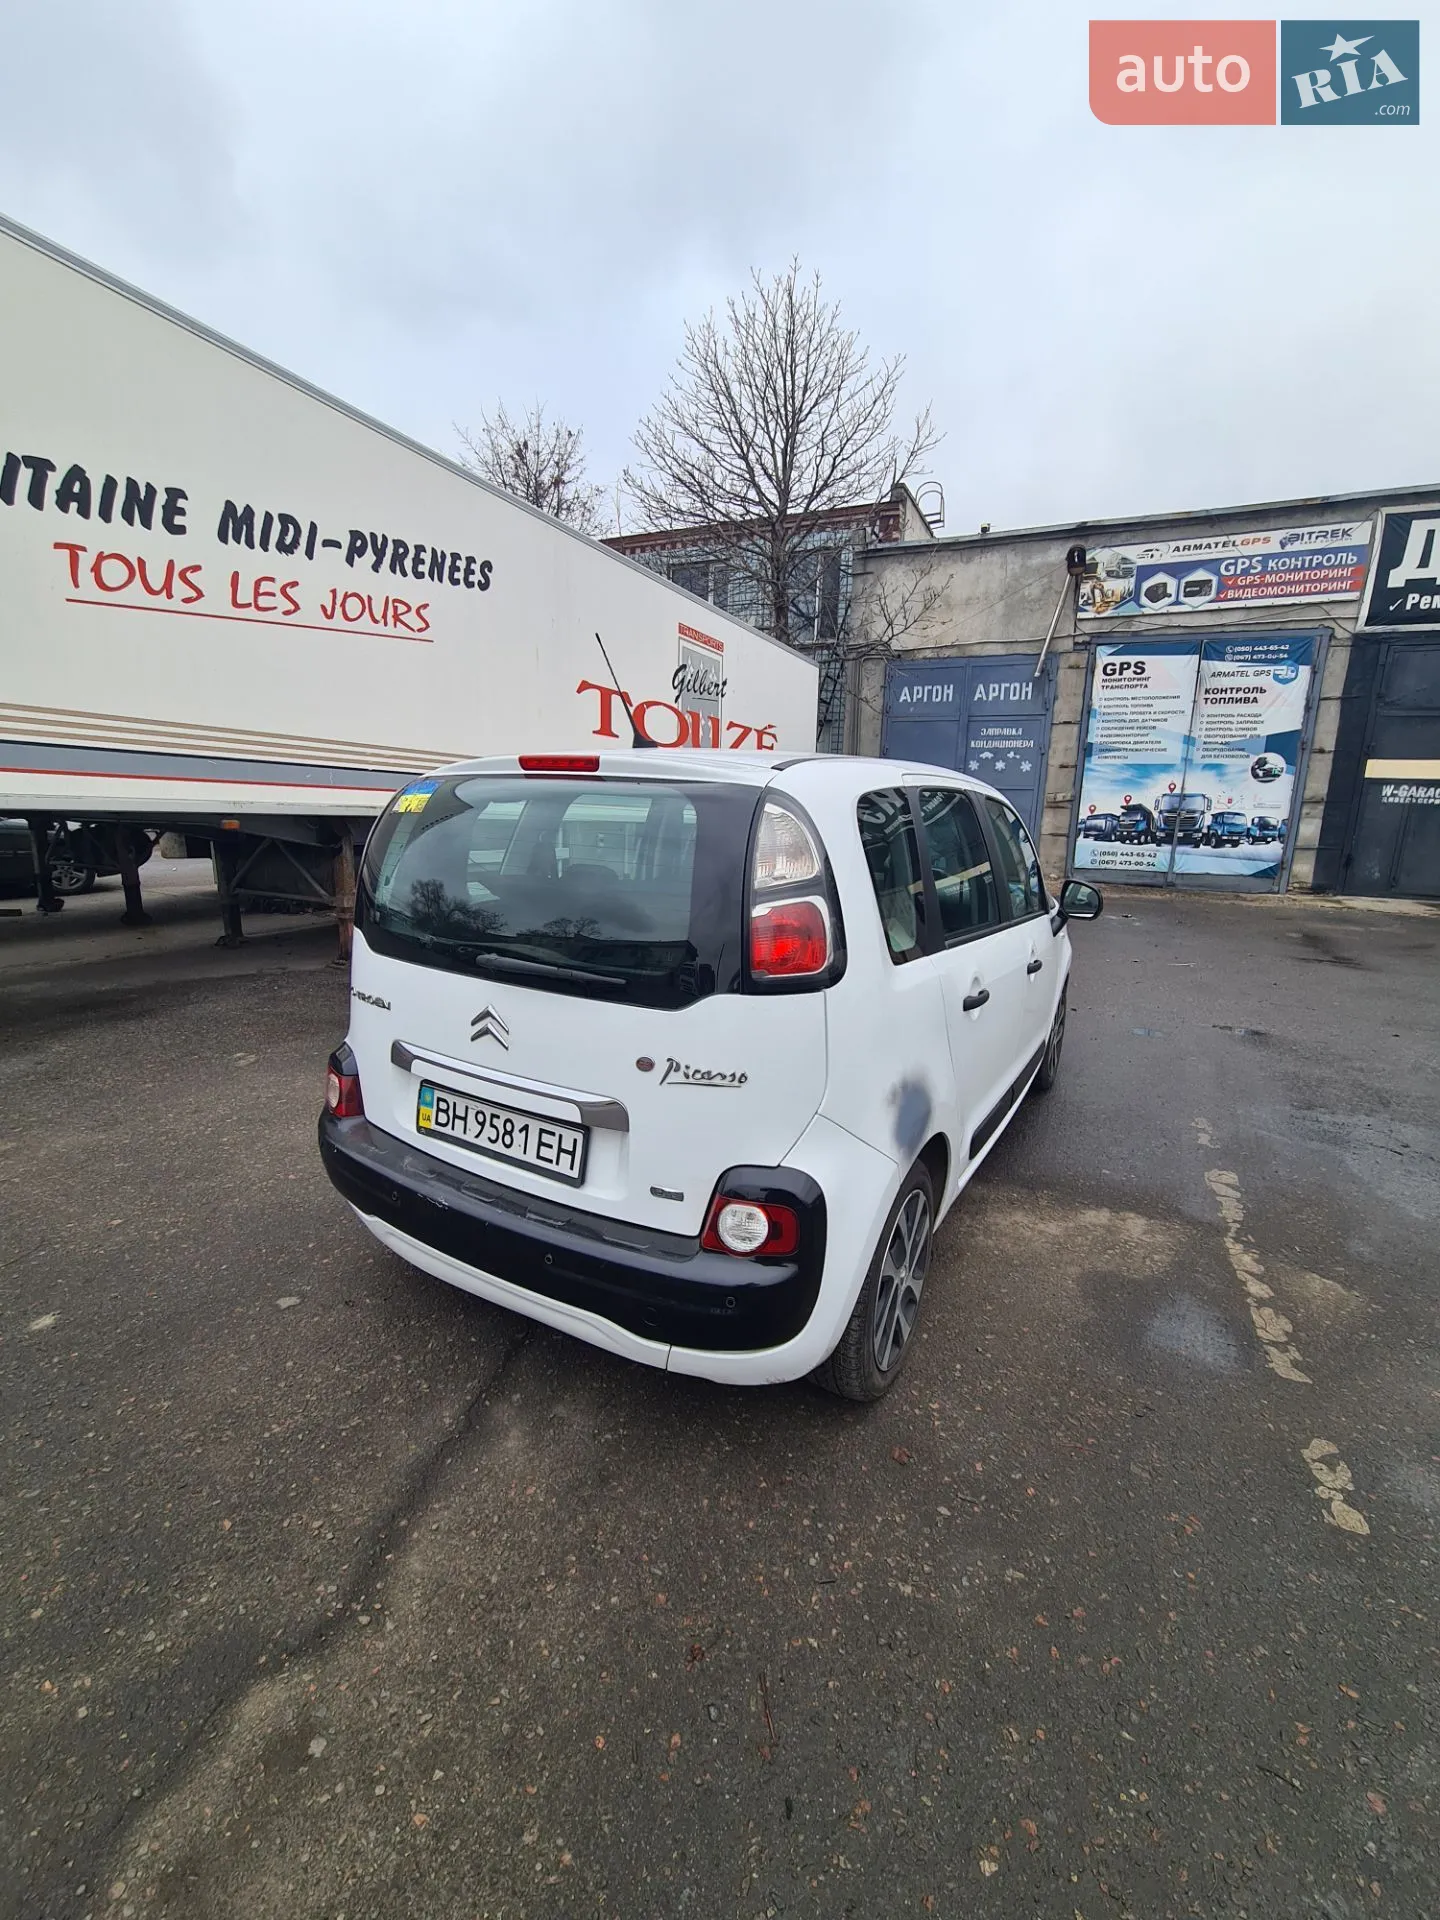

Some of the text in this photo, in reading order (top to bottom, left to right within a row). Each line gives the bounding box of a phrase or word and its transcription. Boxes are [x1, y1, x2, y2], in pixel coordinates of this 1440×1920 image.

[217, 500, 494, 592] MIDI-PYRENEES
[1219, 552, 1358, 576] GPS КОНТРОЛЬ
[1237, 566, 1356, 585] GPS-МОНИТОРИНГ
[53, 541, 432, 634] TOUS LES JOURS
[1226, 580, 1355, 600] ВИДЕОМОНИТОРИНГ
[679, 623, 724, 651] TRANSPORTS
[1102, 660, 1147, 676] GPS
[1210, 669, 1272, 679] ARMATEL GPS
[672, 663, 728, 704] Gilbert
[1101, 676, 1152, 684] МОНИТОРИНГ
[899, 684, 954, 703] АРГОН
[973, 682, 1034, 702] АРГОН
[1204, 686, 1267, 695] КОНТРОЛЬ
[1203, 696, 1259, 705] ТОПЛИВА
[980, 727, 1023, 736] ЗАПРАВКА
[970, 739, 1034, 749] КОНДИЦИОНЕРА
[1098, 859, 1156, 868] (067) 473-00-54
[1119, 851, 1158, 859] 443-65-42
[658, 1057, 749, 1087] Picasso
[421, 1112, 432, 1123] UA
[434, 1096, 578, 1172] BH 9581 EH
